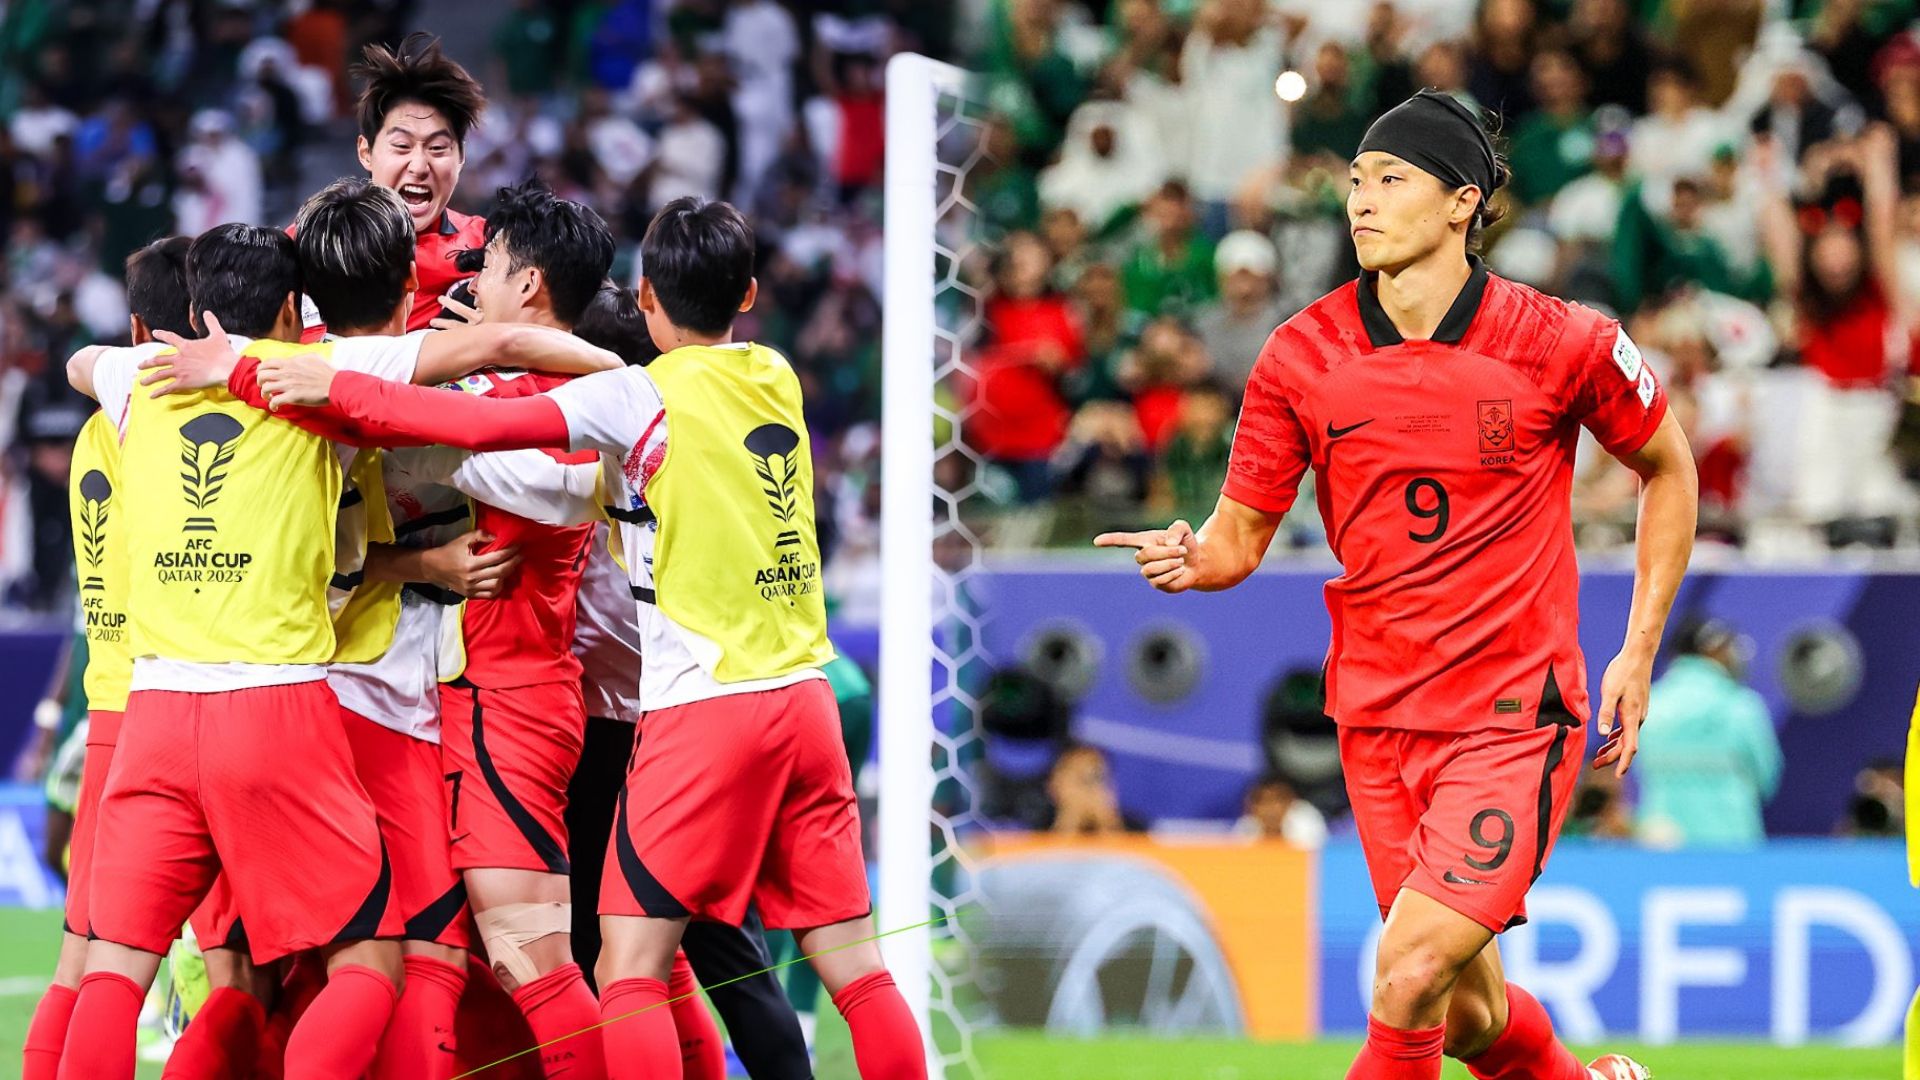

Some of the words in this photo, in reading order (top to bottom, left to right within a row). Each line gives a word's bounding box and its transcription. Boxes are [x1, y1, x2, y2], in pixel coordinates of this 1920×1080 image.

[1480, 455, 1516, 466] KOREA
[1404, 478, 1449, 544] 9
[185, 538, 213, 550] AFC
[154, 552, 208, 568] ASIAN
[211, 552, 252, 568] CUP
[778, 552, 800, 564] AFC
[158, 569, 203, 584] QATAR
[83, 597, 103, 609] AFC
[102, 612, 126, 628] CUP
[445, 770, 463, 831] 7
[1464, 808, 1514, 871] 9
